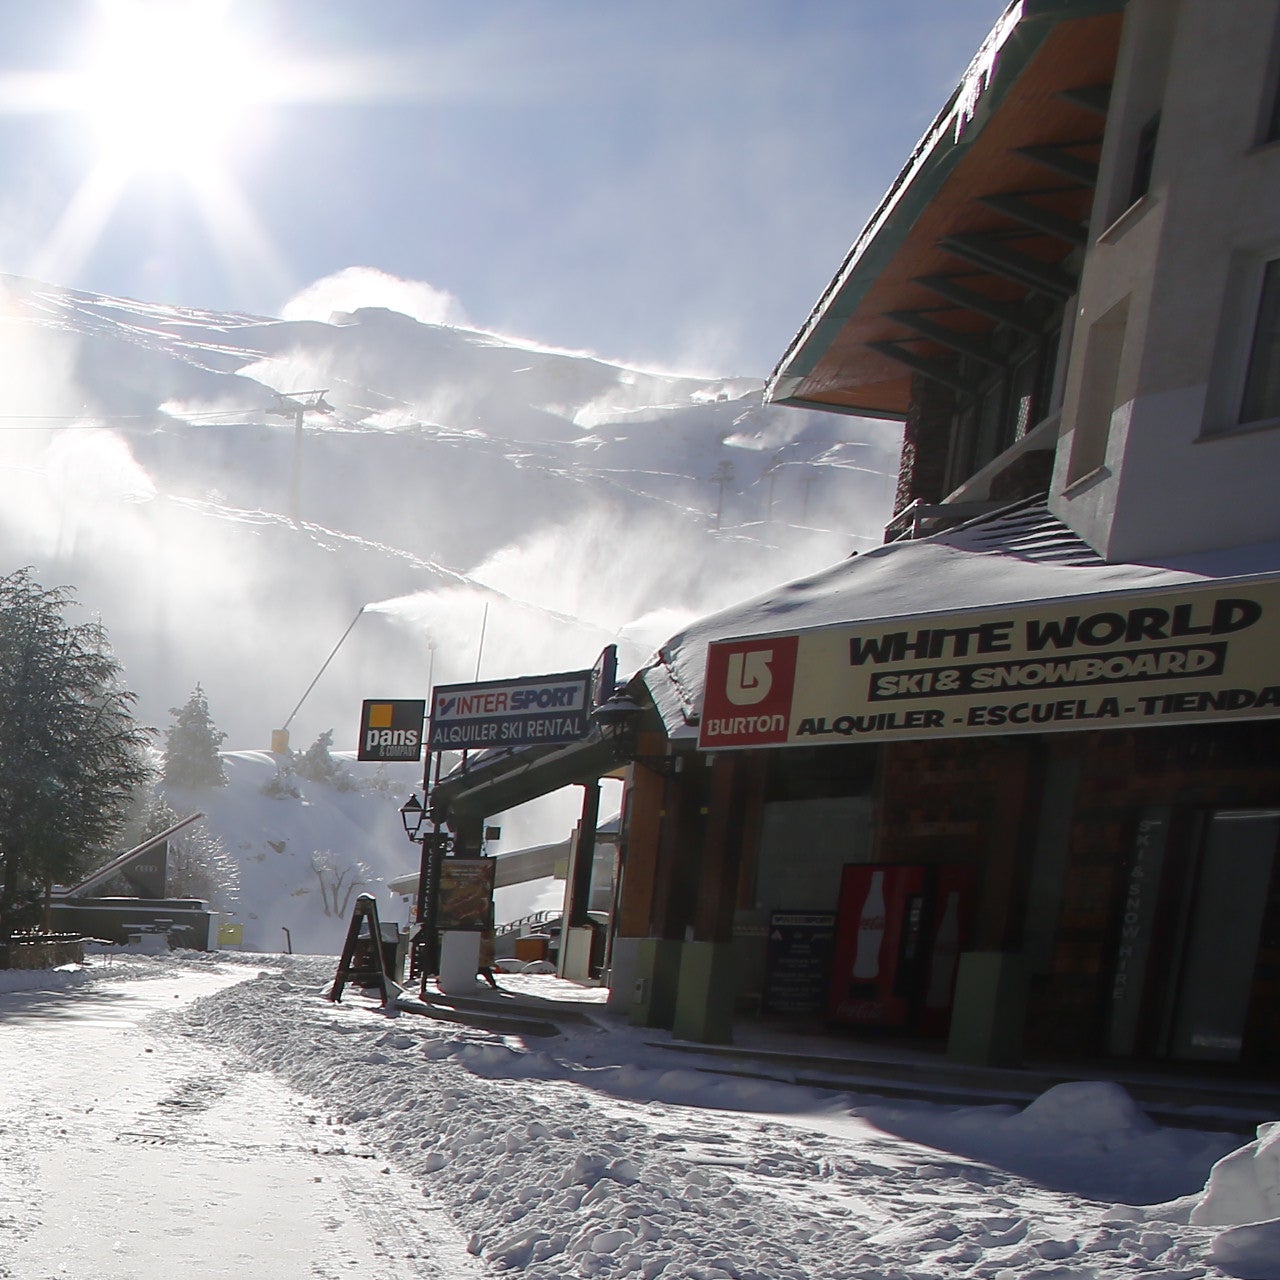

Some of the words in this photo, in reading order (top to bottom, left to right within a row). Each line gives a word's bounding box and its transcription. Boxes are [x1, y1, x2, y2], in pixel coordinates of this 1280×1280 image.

[849, 620, 1014, 666] WHITE
[1026, 598, 1262, 652] WORLD
[875, 671, 933, 696] SKI
[934, 669, 960, 691] &
[970, 649, 1217, 690] SNOWBOARD
[707, 714, 784, 737] BURTON
[796, 709, 945, 736] ALQUILER
[967, 697, 1120, 727] ESCUELA
[366, 728, 418, 751] pans
[433, 726, 497, 744] ALQUILER
[500, 722, 522, 740] SKI
[527, 718, 581, 737] RENTAL
[386, 746, 416, 757] COMPANY
